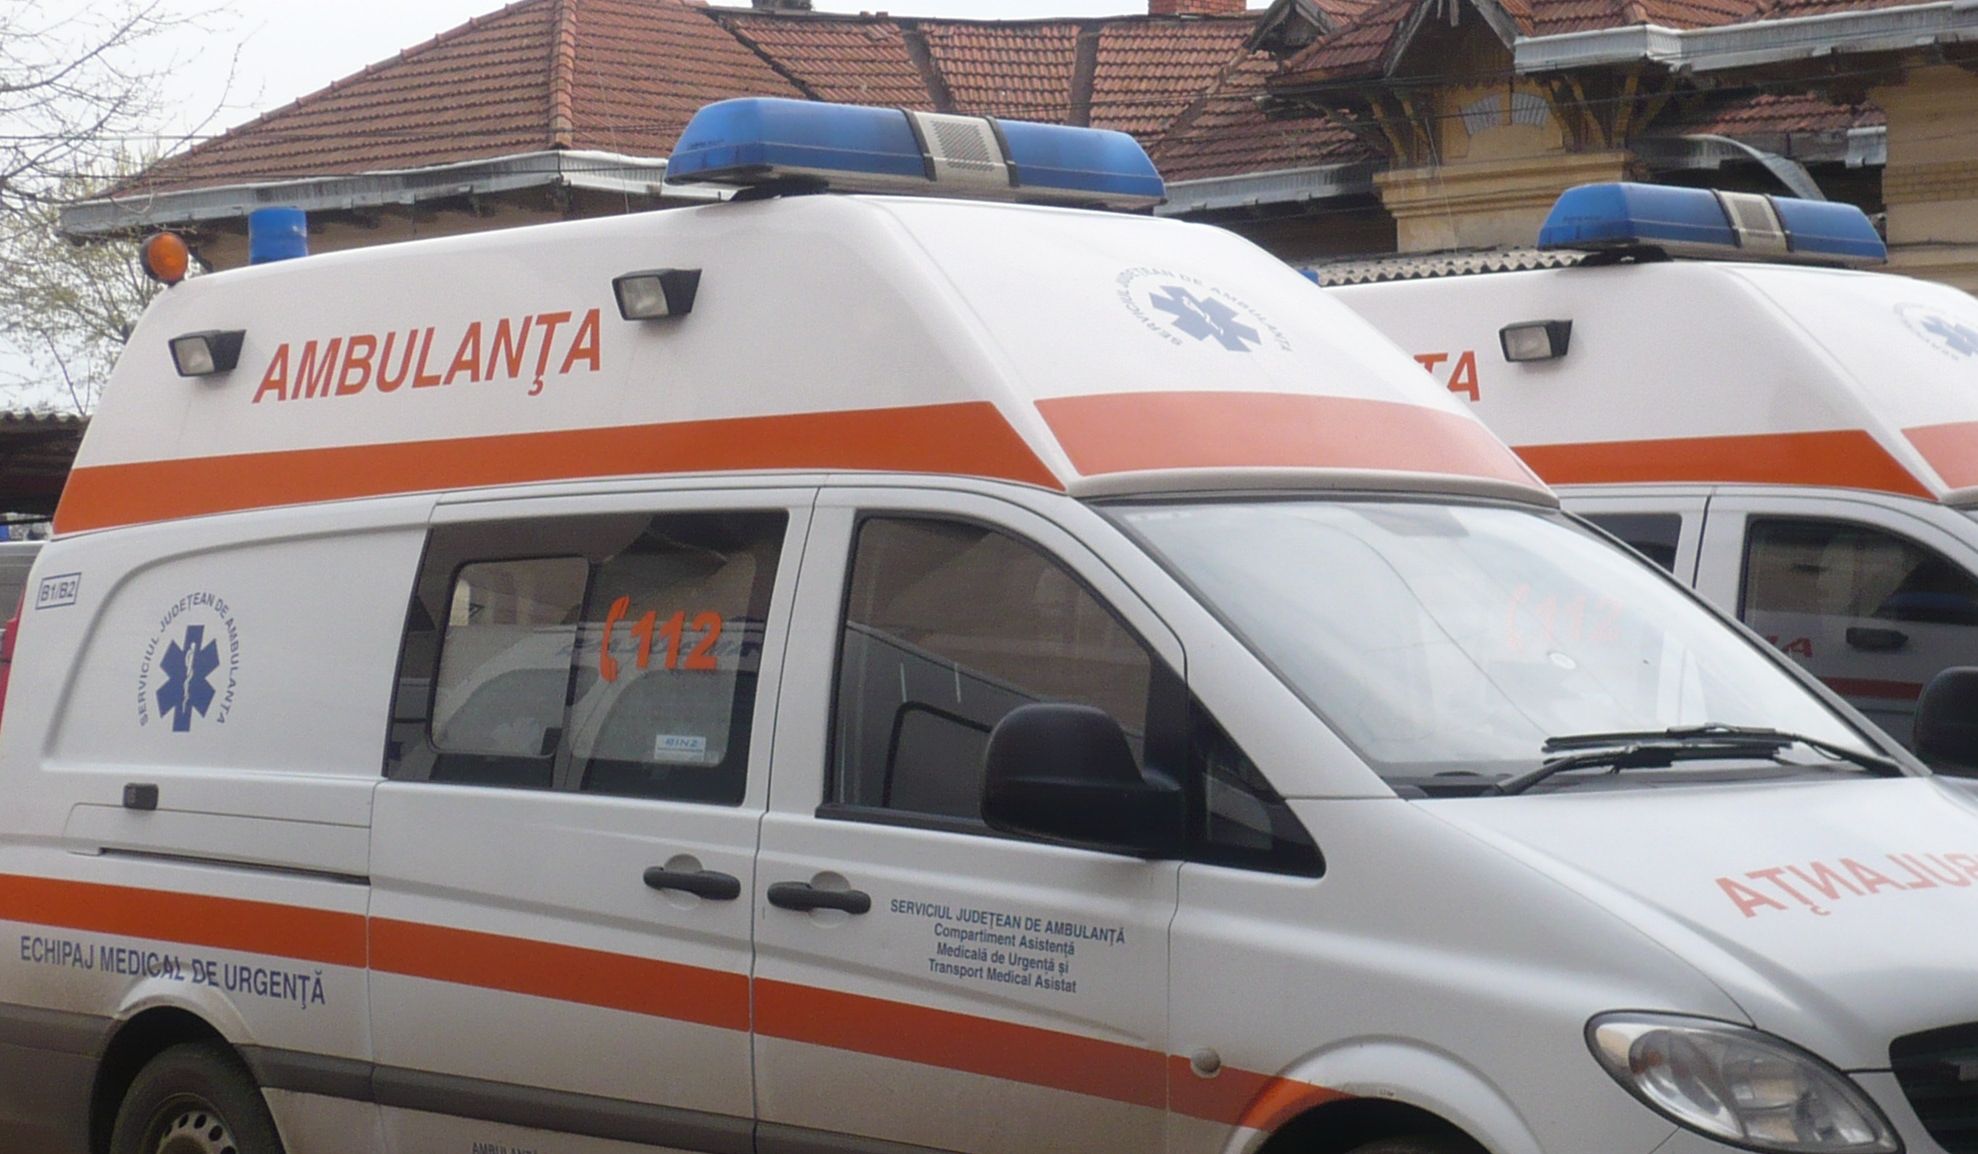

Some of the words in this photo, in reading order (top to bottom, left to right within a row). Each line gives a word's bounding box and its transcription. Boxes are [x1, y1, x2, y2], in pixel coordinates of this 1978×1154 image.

[251, 308, 601, 403] AMBULANŢA
[40, 580, 76, 602] B1/B2
[630, 610, 724, 671] 112
[137, 636, 160, 727] SERVICIUL
[214, 598, 230, 619] DE
[890, 899, 953, 920] SERVICIUL
[1024, 917, 1042, 932] DE
[934, 923, 1016, 947] Compartiment
[20, 935, 95, 970] ECHIPAJ
[100, 946, 186, 983] MEDICAL
[192, 958, 220, 987] DE
[936, 942, 988, 962] Medicală
[990, 950, 1006, 965] de
[928, 958, 984, 979] Transport
[986, 967, 1032, 986] Medical
[1034, 974, 1077, 993] Asistat
